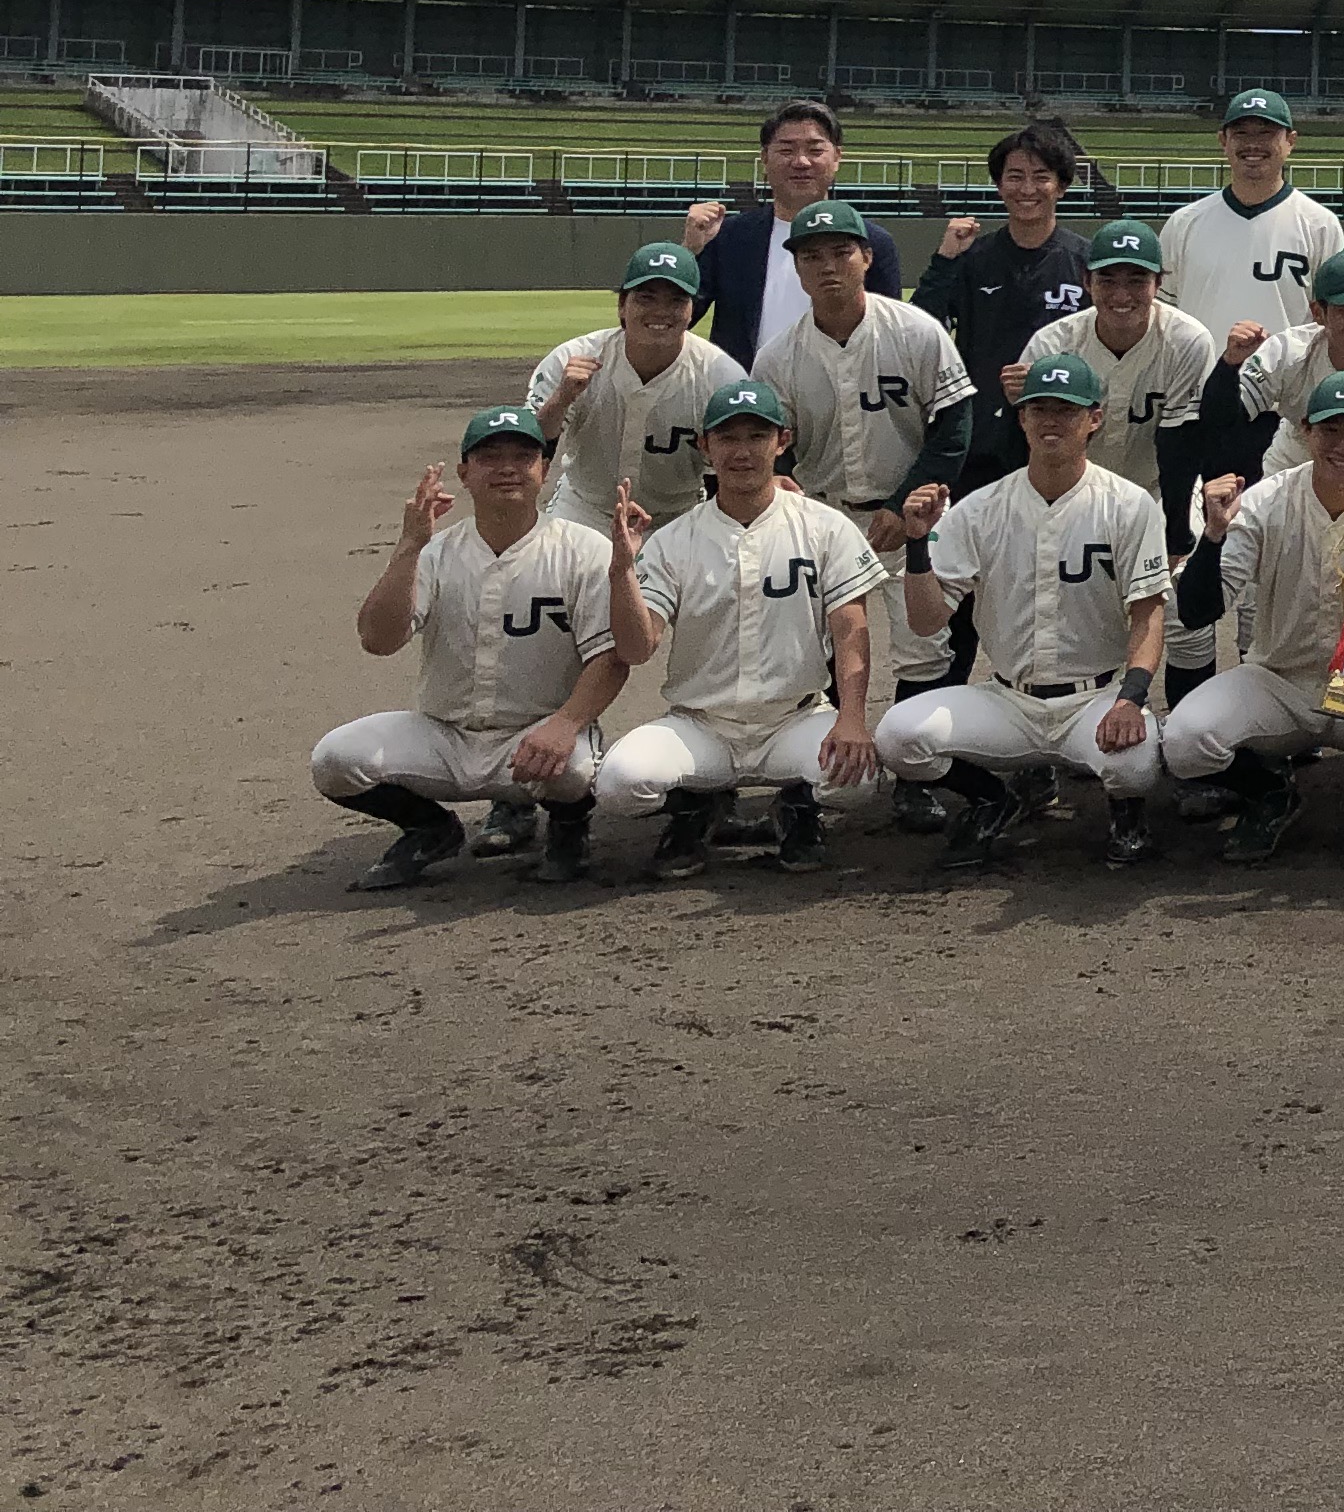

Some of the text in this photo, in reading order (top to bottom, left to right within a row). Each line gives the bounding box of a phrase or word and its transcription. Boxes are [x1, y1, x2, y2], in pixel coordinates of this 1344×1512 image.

[1242, 97, 1267, 109] JR
[806, 212, 834, 227] JR
[1112, 235, 1141, 251] JR
[648, 253, 678, 269] JR
[1253, 250, 1309, 288] JR
[1045, 283, 1083, 306] JR
[1041, 368, 1070, 384] JR
[728, 390, 758, 405] JR
[860, 375, 909, 412] JR
[488, 412, 520, 427] JR
[855, 550, 876, 569] EAST
[1143, 555, 1163, 572] EAST
[764, 557, 819, 599] JR
[504, 597, 573, 638] JR
